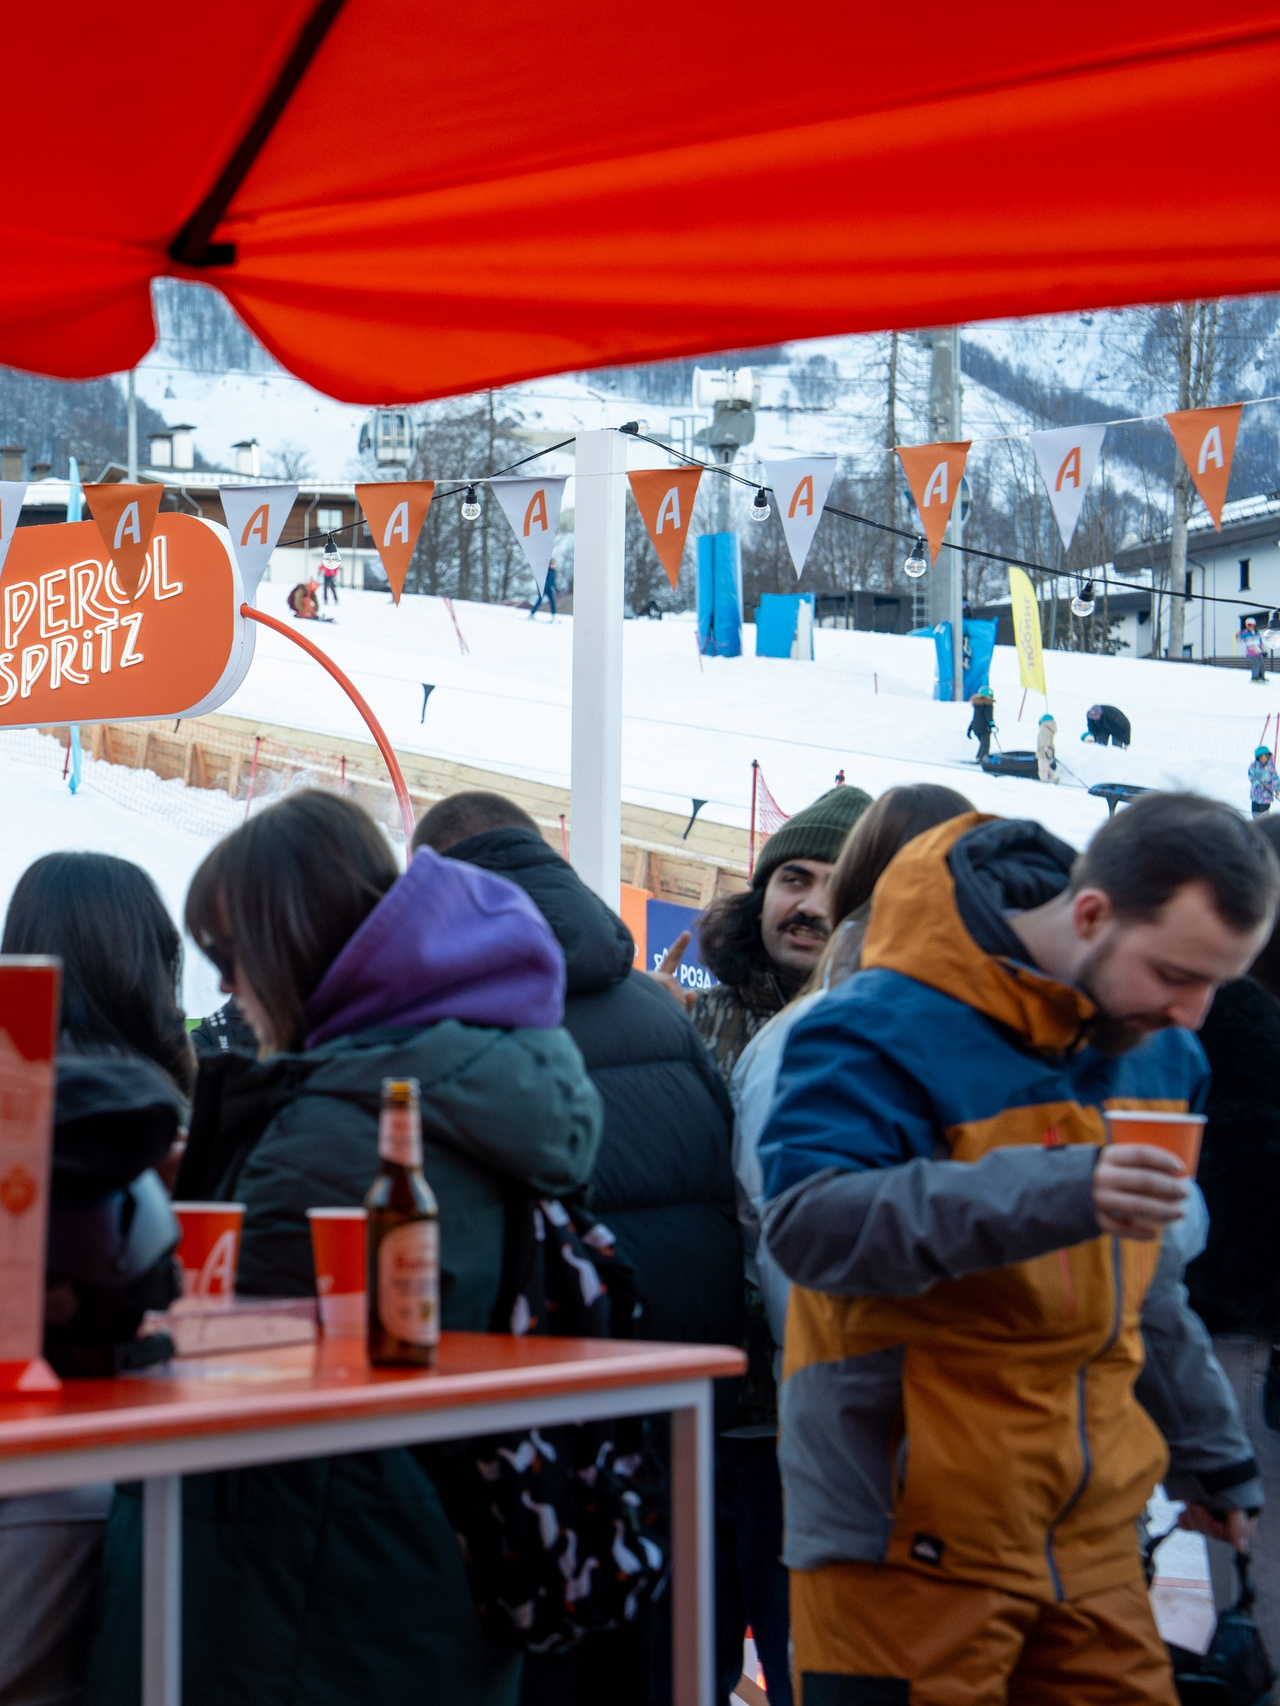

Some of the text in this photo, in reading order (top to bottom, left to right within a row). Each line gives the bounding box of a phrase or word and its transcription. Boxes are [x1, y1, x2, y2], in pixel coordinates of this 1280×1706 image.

[1055, 446, 1081, 492] A
[1197, 425, 1224, 475] A
[787, 475, 813, 519] A
[923, 461, 948, 508] A
[113, 501, 141, 550] A
[240, 503, 270, 546] A
[383, 501, 409, 547] A
[523, 489, 548, 537] A
[655, 486, 681, 535] A
[680, 964, 711, 989] РОЗА
